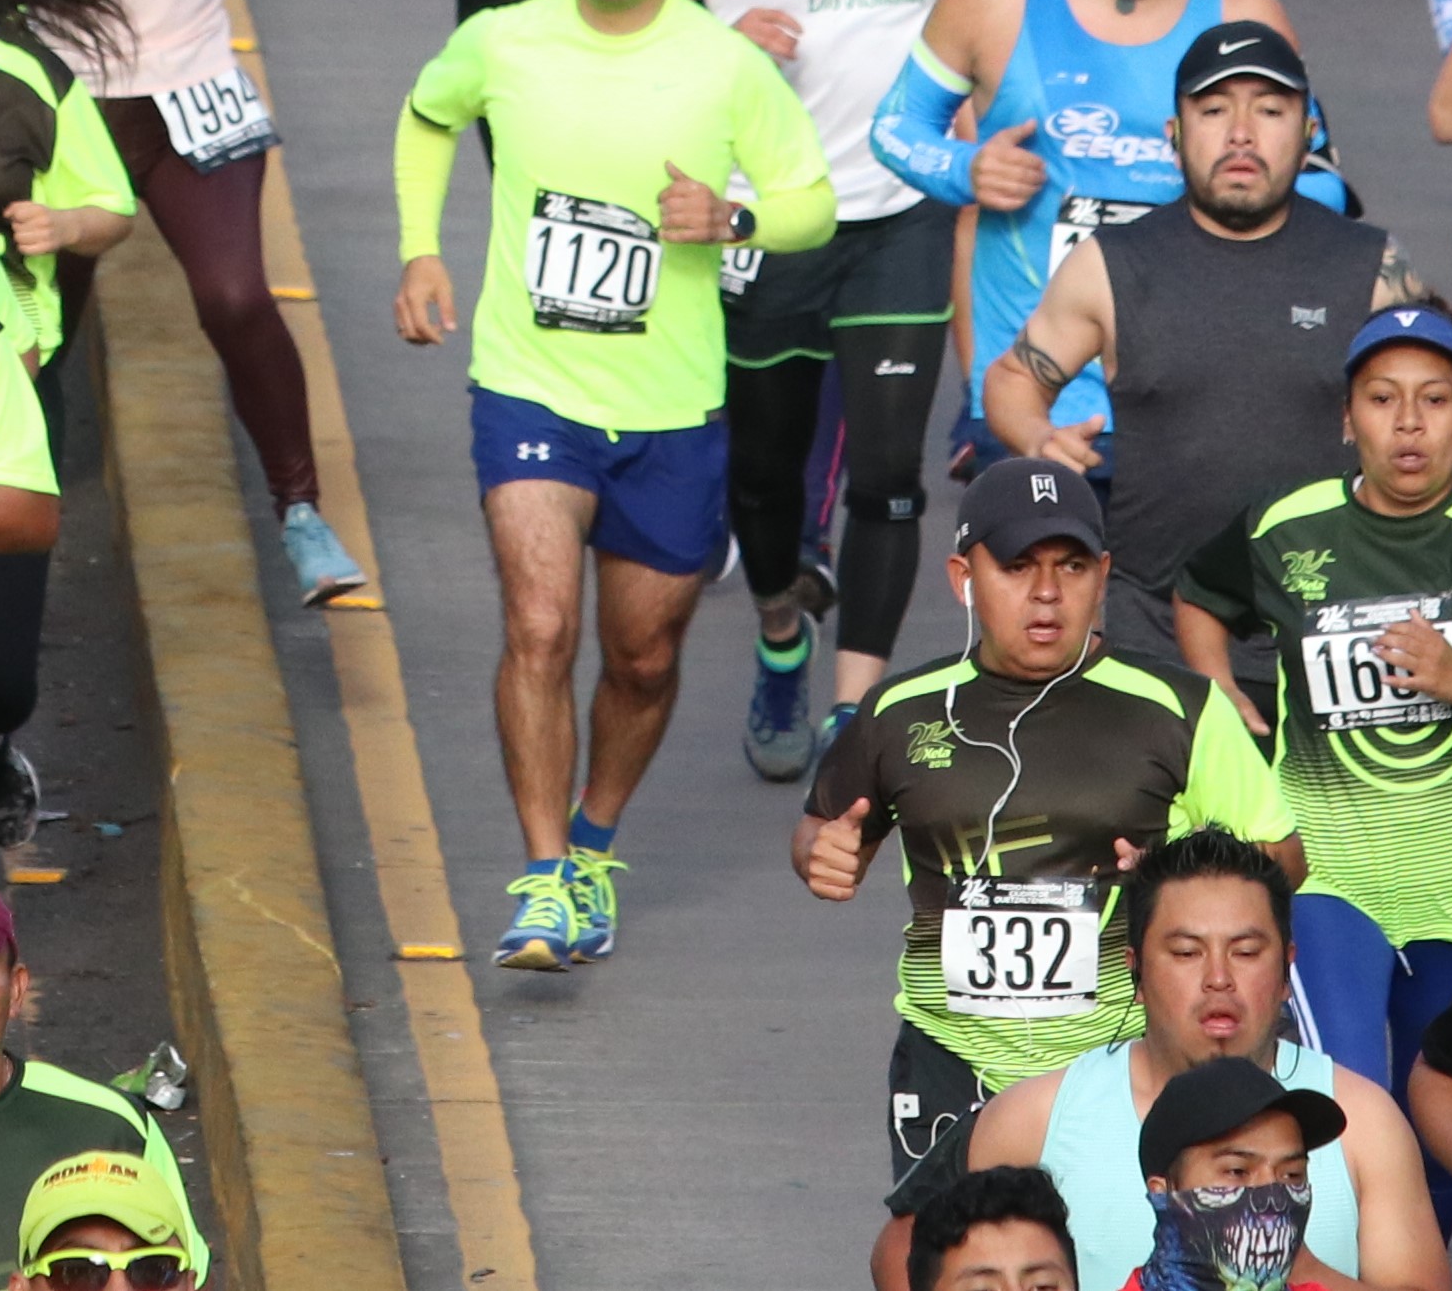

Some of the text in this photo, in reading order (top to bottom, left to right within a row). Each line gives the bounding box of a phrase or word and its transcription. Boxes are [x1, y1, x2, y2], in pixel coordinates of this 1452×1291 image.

[536, 232, 652, 309] 1120
[924, 746, 952, 760] Xela
[968, 915, 1073, 992] 332
